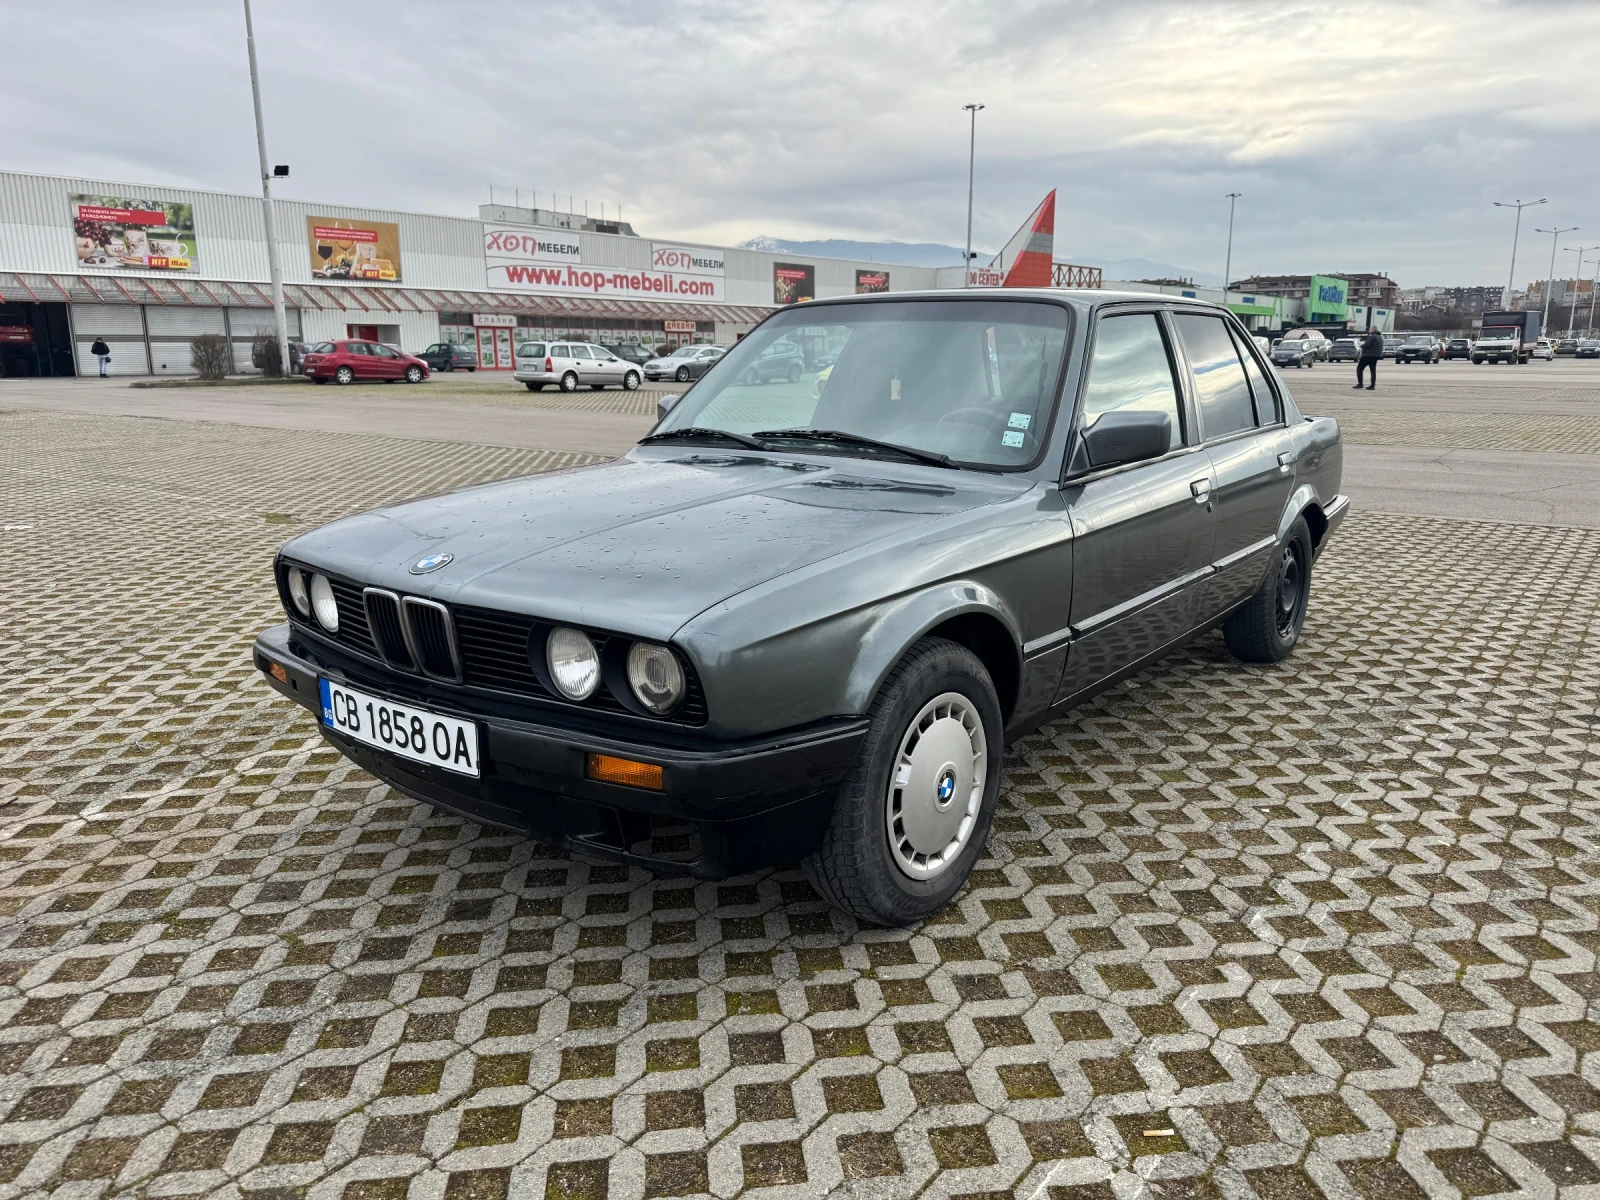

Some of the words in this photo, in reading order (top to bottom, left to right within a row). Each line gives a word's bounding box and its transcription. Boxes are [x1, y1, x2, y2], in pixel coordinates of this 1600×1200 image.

[486, 232, 537, 256] ХОП
[537, 242, 580, 256] МЕБЕЛИ
[151, 258, 167, 266] HIT
[653, 249, 691, 270] ХОП
[692, 257, 724, 269] МЕБЕЛИ
[505, 265, 715, 296] www.hop-mebeli.com
[477, 316, 514, 325] СПАЛНИ
[665, 321, 696, 331] ДНЕВНИ
[324, 707, 333, 720] BG
[333, 689, 360, 732] CB
[366, 702, 426, 754] 1858
[433, 721, 472, 768] OA
